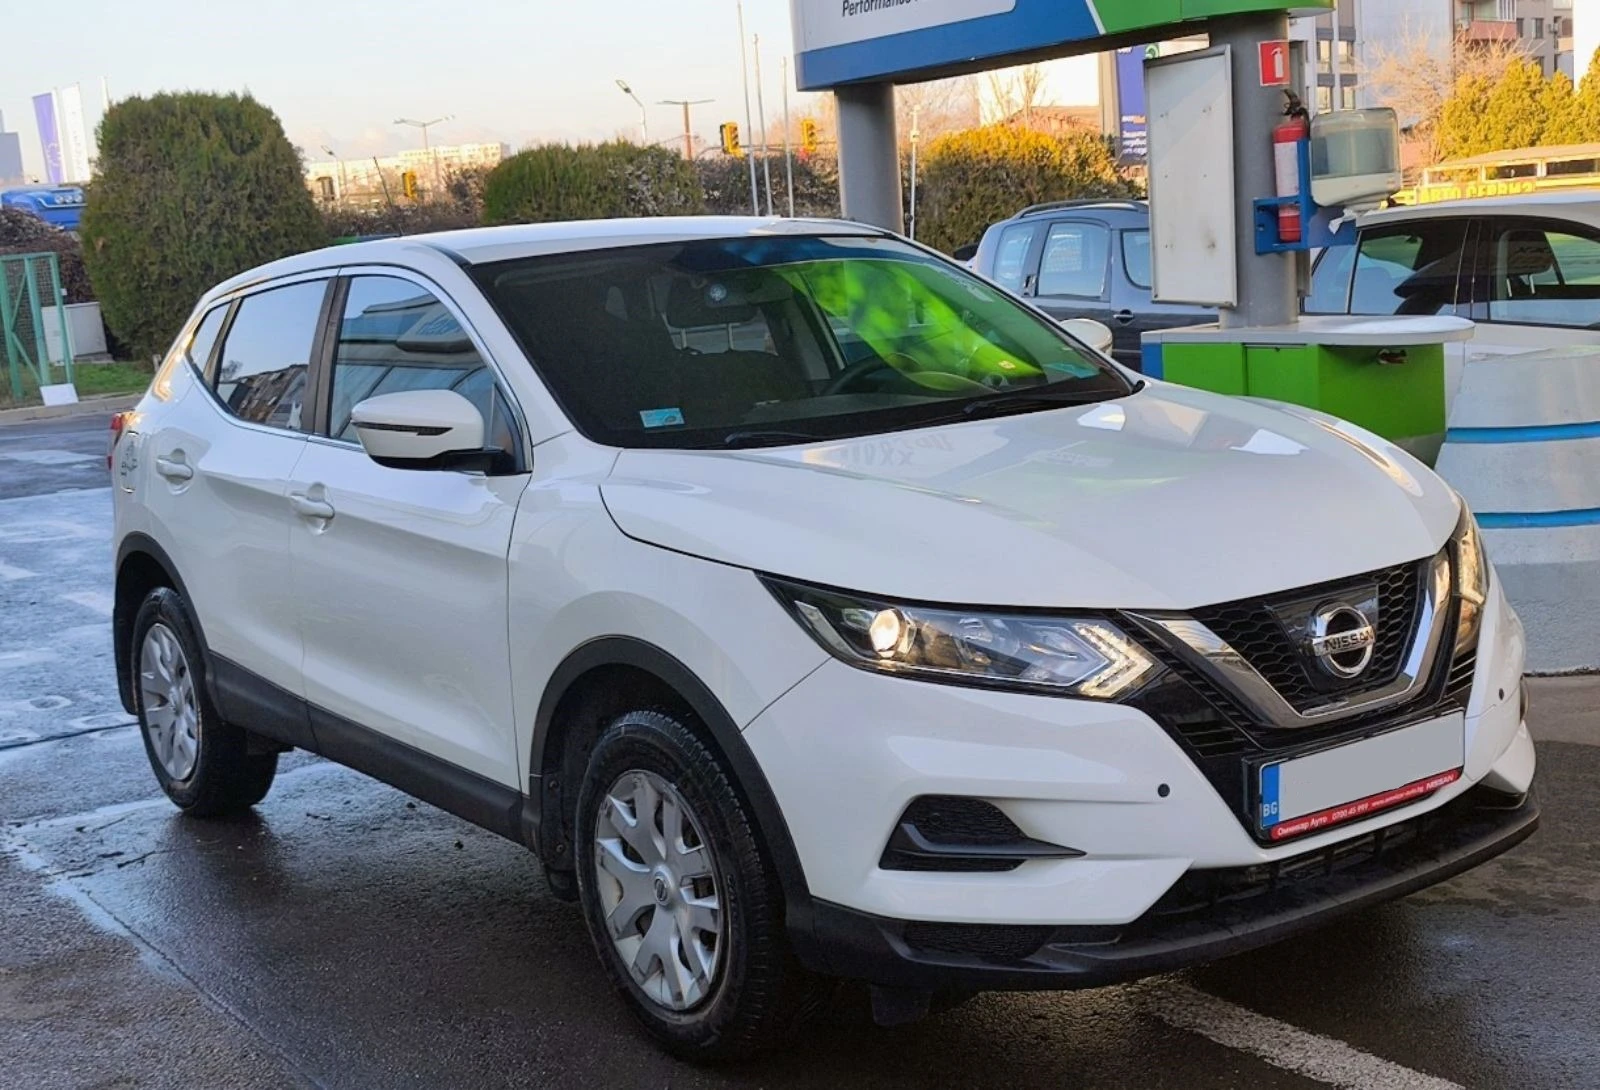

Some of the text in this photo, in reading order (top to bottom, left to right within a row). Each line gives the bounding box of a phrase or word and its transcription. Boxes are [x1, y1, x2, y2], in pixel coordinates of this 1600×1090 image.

[1324, 630, 1374, 651] NISSAN
[1426, 774, 1455, 791] NISSAN
[1263, 801, 1278, 817] BG
